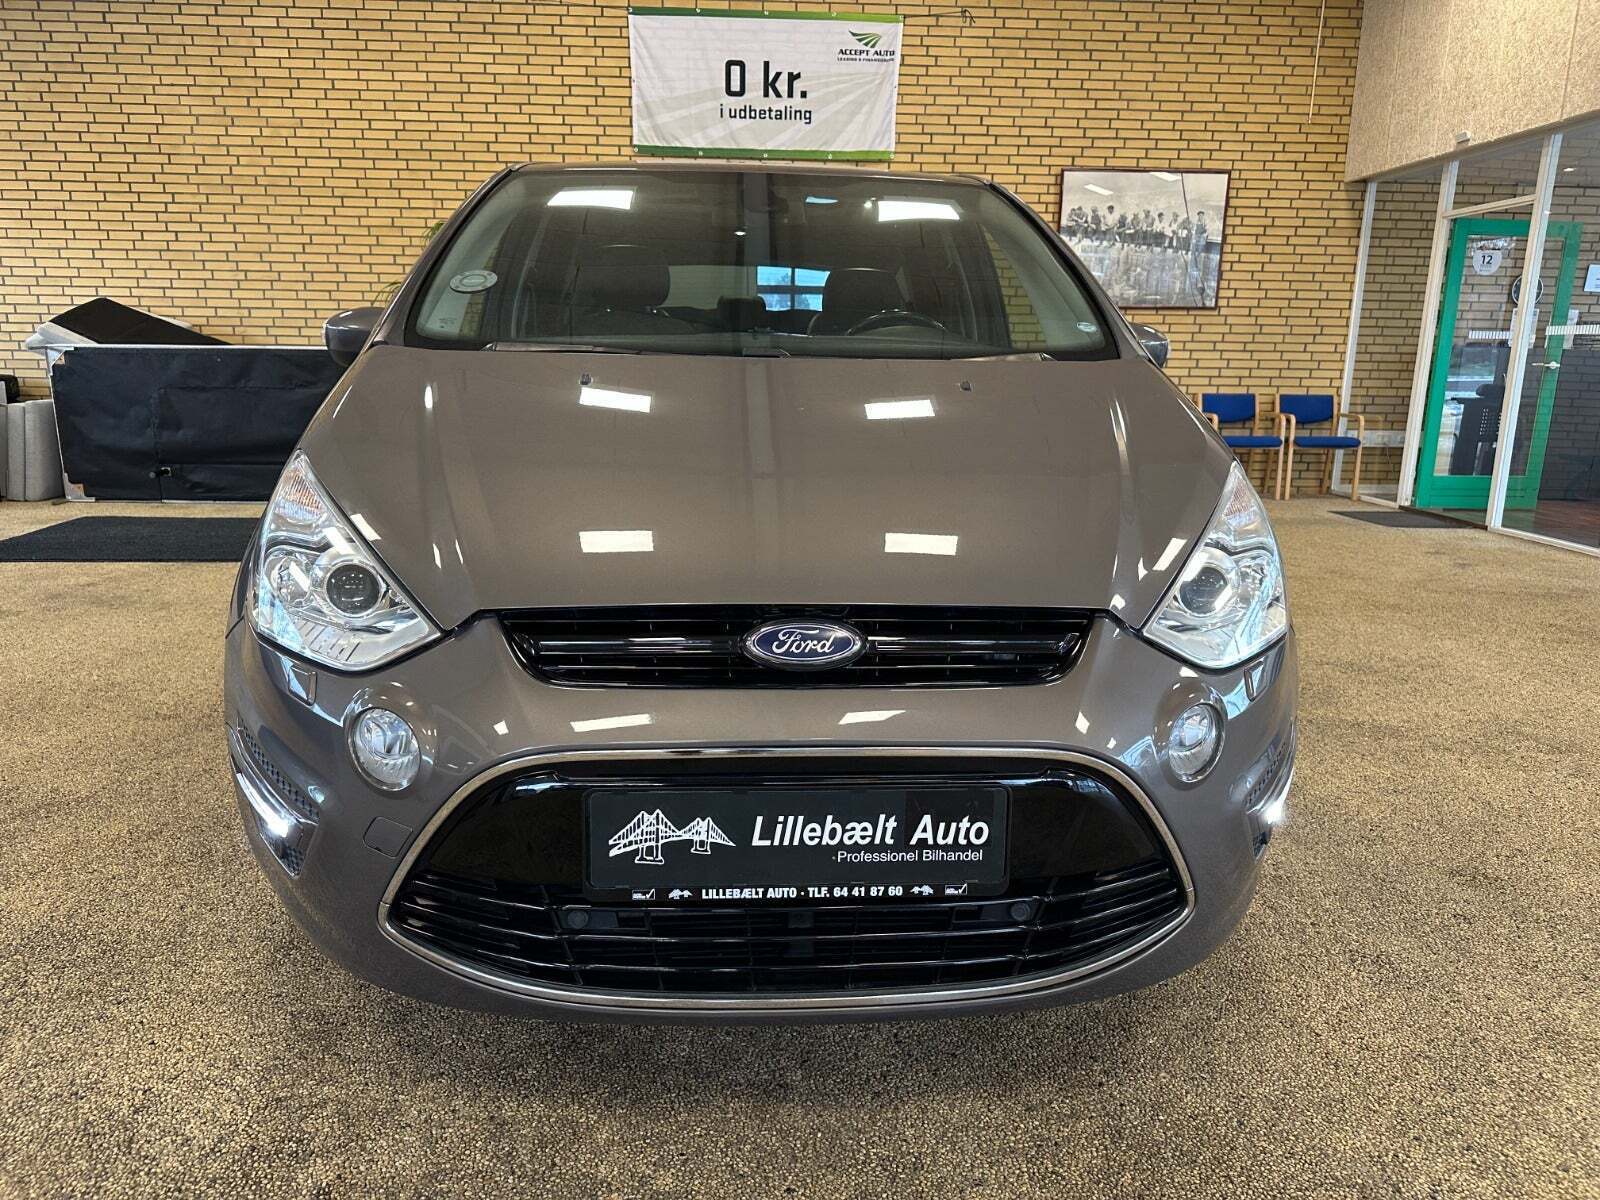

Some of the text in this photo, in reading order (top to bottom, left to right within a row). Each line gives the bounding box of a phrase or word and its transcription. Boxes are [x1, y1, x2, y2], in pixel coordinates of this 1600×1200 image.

[838, 48, 870, 56] ACCEPT
[725, 60, 807, 98] 0 kr.
[720, 103, 812, 124] i udbetaling
[1481, 255, 1493, 265] 12
[772, 629, 835, 653] Ford
[751, 814, 989, 847] Lillebælt Auto
[837, 849, 983, 863] Professionel Bilhandel
[702, 888, 764, 899] LILLEBÆLT
[767, 888, 797, 898] AUTO
[808, 887, 830, 897] TLF.
[833, 887, 848, 897] 64
[851, 887, 865, 896] 41
[870, 886, 884, 896] 87
[888, 886, 903, 896] 60
